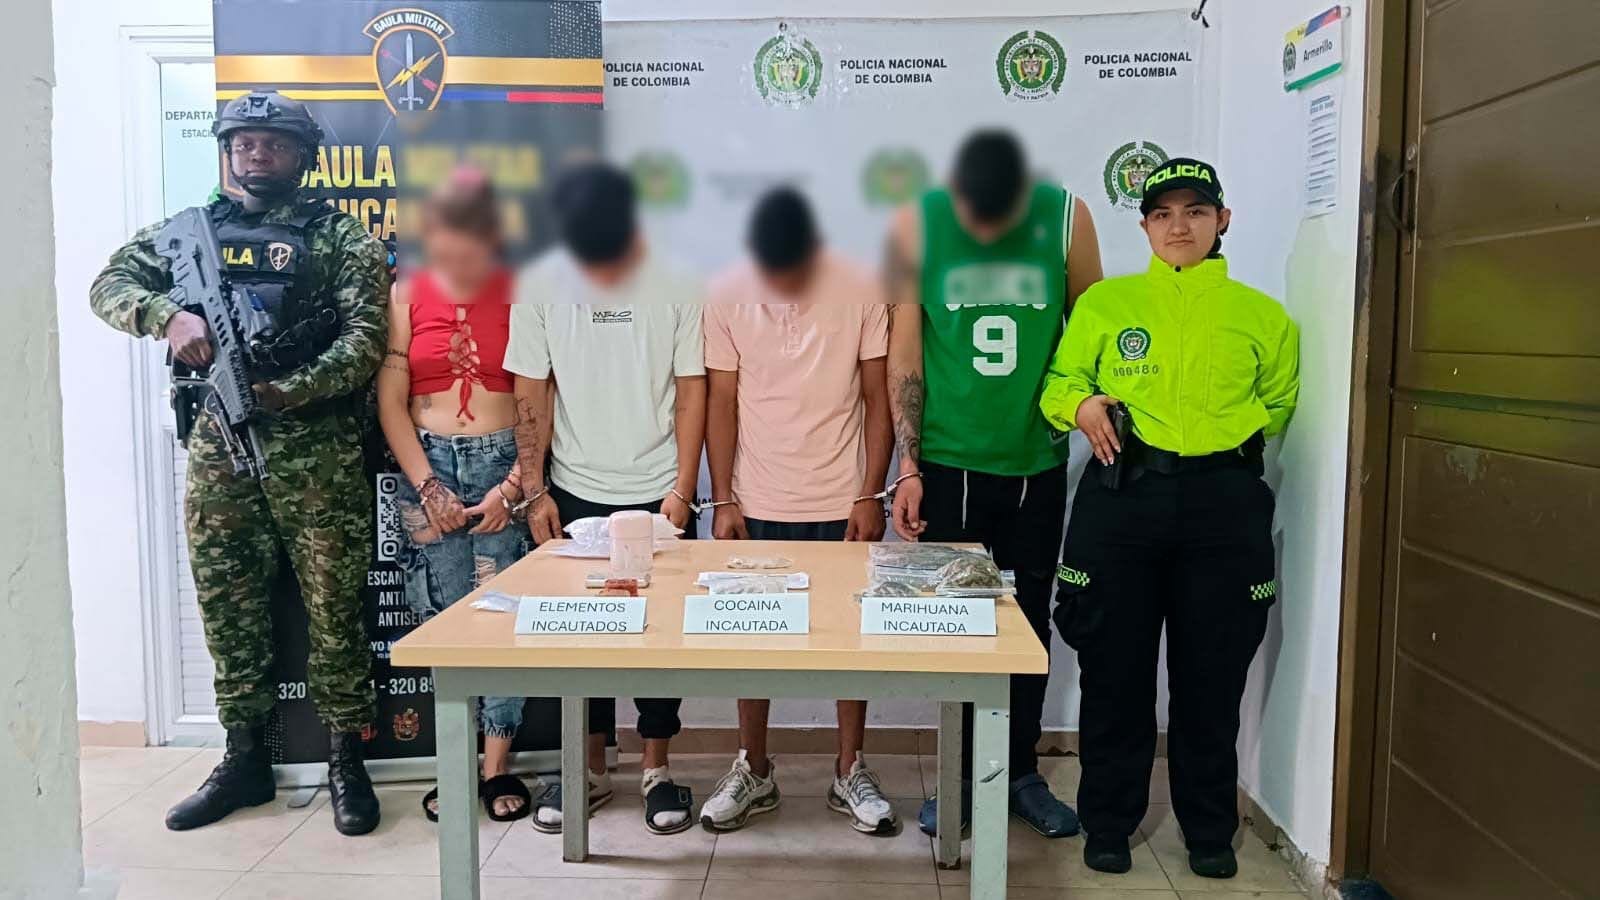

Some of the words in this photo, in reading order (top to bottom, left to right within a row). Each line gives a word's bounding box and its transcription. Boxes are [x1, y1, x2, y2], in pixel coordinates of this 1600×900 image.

[373, 13, 404, 33] GAULA
[404, 12, 445, 34] MILITAR
[1303, 39, 1333, 61] Armerillo
[840, 60, 885, 69] POLICIA
[888, 58, 947, 69] NACIONAL
[1084, 54, 1130, 64] POLICIA
[1134, 52, 1192, 62] NACIONAL
[603, 63, 643, 72] OLICIA
[647, 62, 704, 72] NACIONAL
[1099, 69, 1114, 79] DE
[1118, 67, 1177, 77] COLOMBIA
[613, 77, 628, 87] DE
[631, 76, 690, 87] COLOMBIA
[855, 74, 870, 84] DE
[873, 73, 932, 84] COLOMBIA
[298, 146, 396, 187] AULA
[1146, 164, 1212, 191] POLICÍA
[973, 315, 1017, 376] 9
[539, 602, 626, 613] ELEMENTOS
[714, 600, 782, 611] COCAINA
[881, 602, 969, 615] MARIHUANA
[531, 620, 627, 632] INCAUTADOS
[706, 620, 788, 631] INCAUTADA
[883, 620, 967, 633] INCAUTADA
[278, 682, 306, 699] 320
[389, 677, 416, 695] 320
